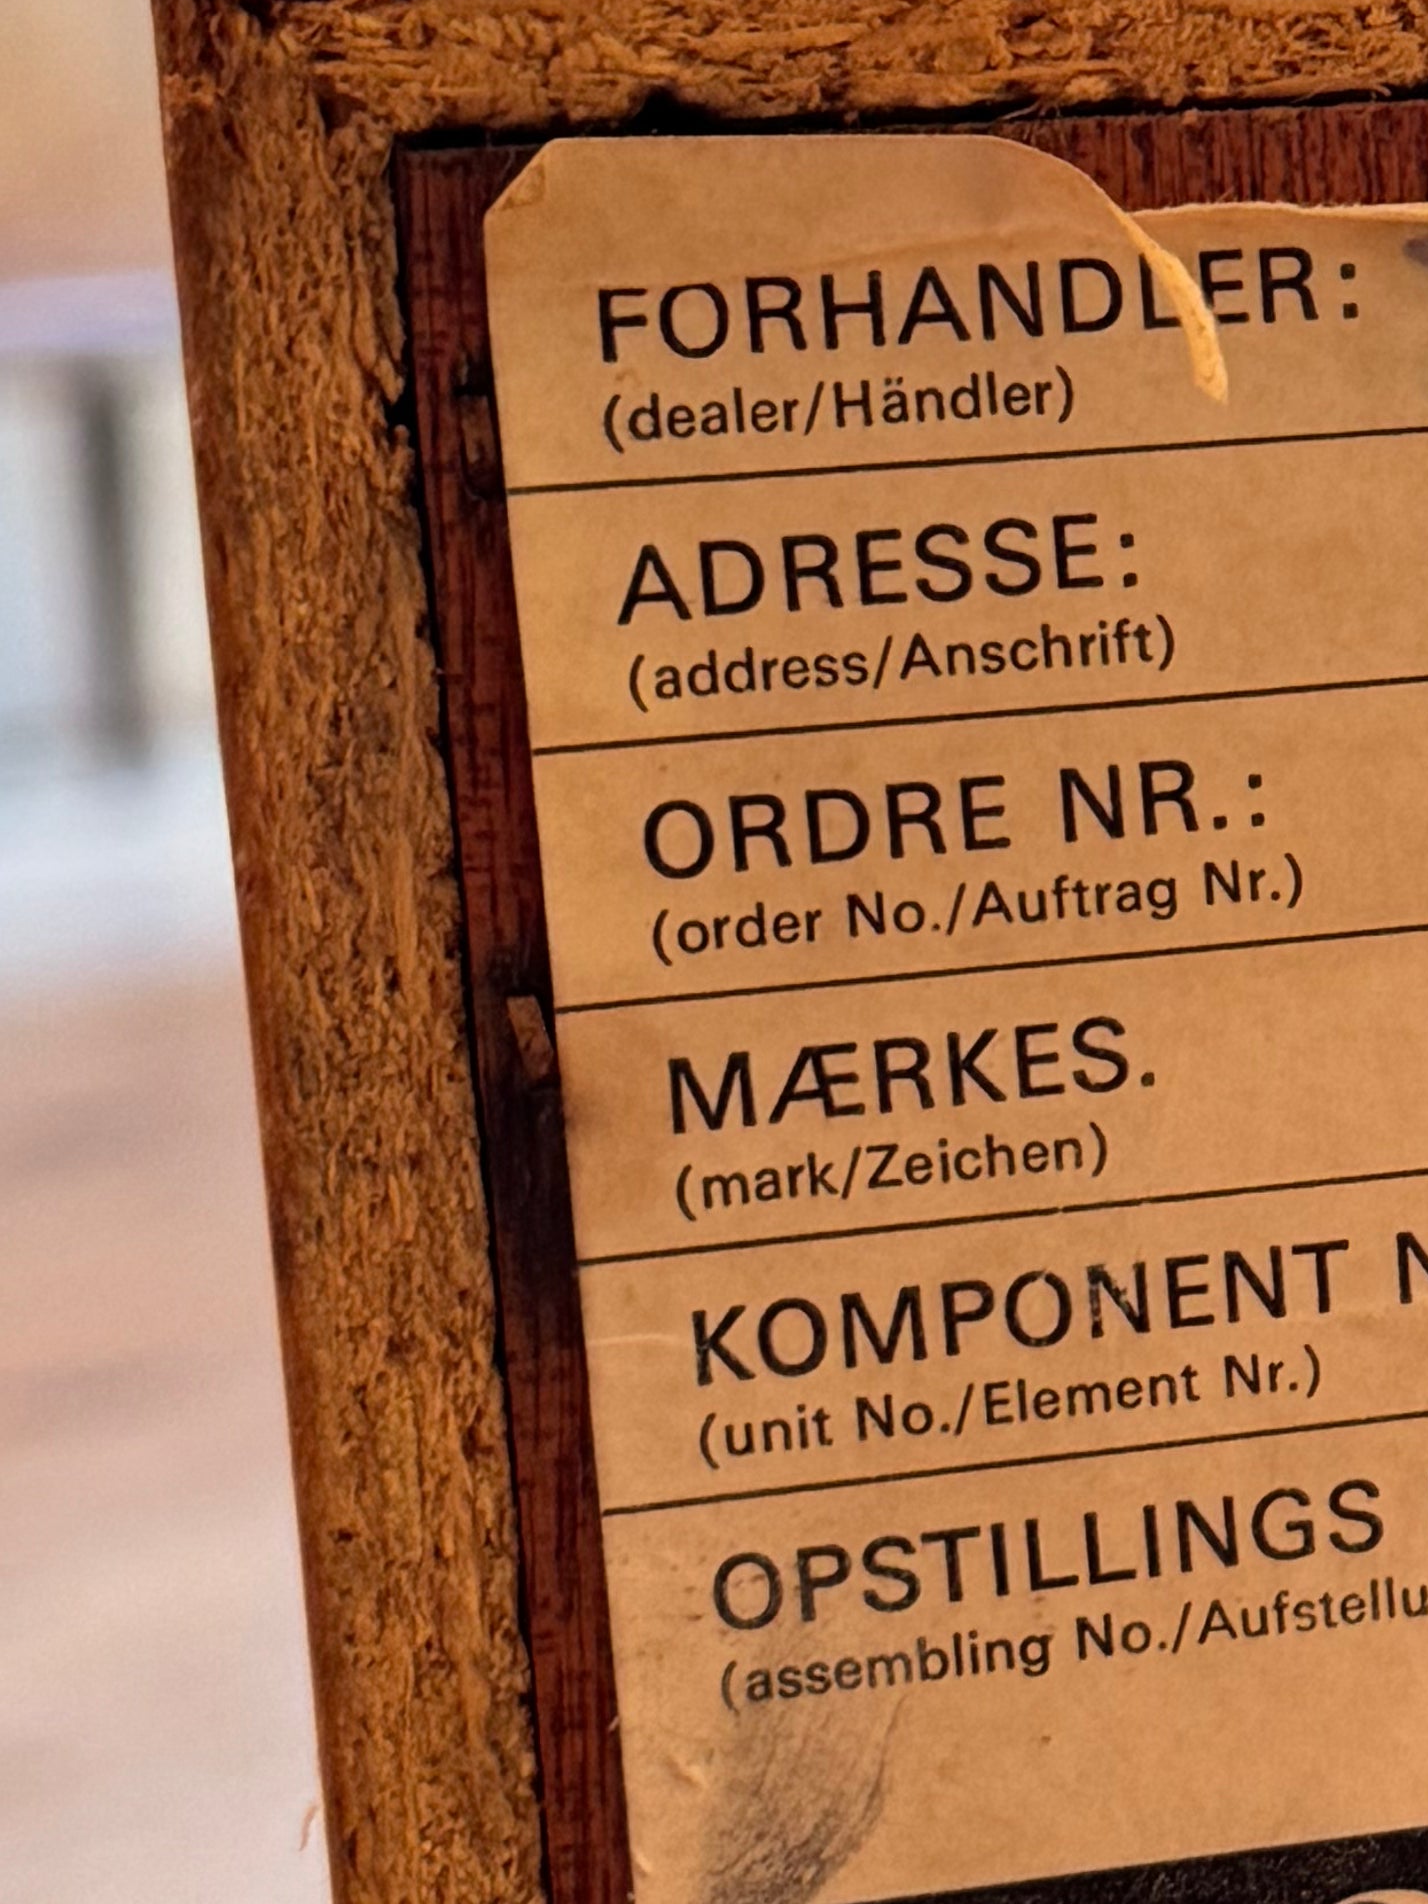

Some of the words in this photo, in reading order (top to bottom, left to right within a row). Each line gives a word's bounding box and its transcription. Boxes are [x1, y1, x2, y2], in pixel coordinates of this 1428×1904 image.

[599, 245, 1360, 364] FORHANDLER:
[602, 366, 1075, 453] (dealer/Händler)
[616, 513, 1139, 625] ADRESSE:
[628, 615, 1175, 712] (address/Anschrift)
[642, 775, 1011, 879] ORDRE
[1058, 758, 1266, 844] NR.:
[653, 909, 822, 965] (order
[847, 874, 1178, 935] No./Auftrag
[1203, 854, 1303, 907] Nr.)
[667, 1016, 1157, 1135] MÆRKES.
[675, 1123, 1109, 1221] (mark/Zeichen)
[692, 1238, 1349, 1385] KOMPONENT
[699, 1406, 835, 1469] (unit
[856, 1363, 1200, 1442] No./Element
[1223, 1346, 1321, 1401] Nr.)
[711, 1476, 1384, 1632] OPSTILLINGS
[720, 1626, 1053, 1711] (assembling
